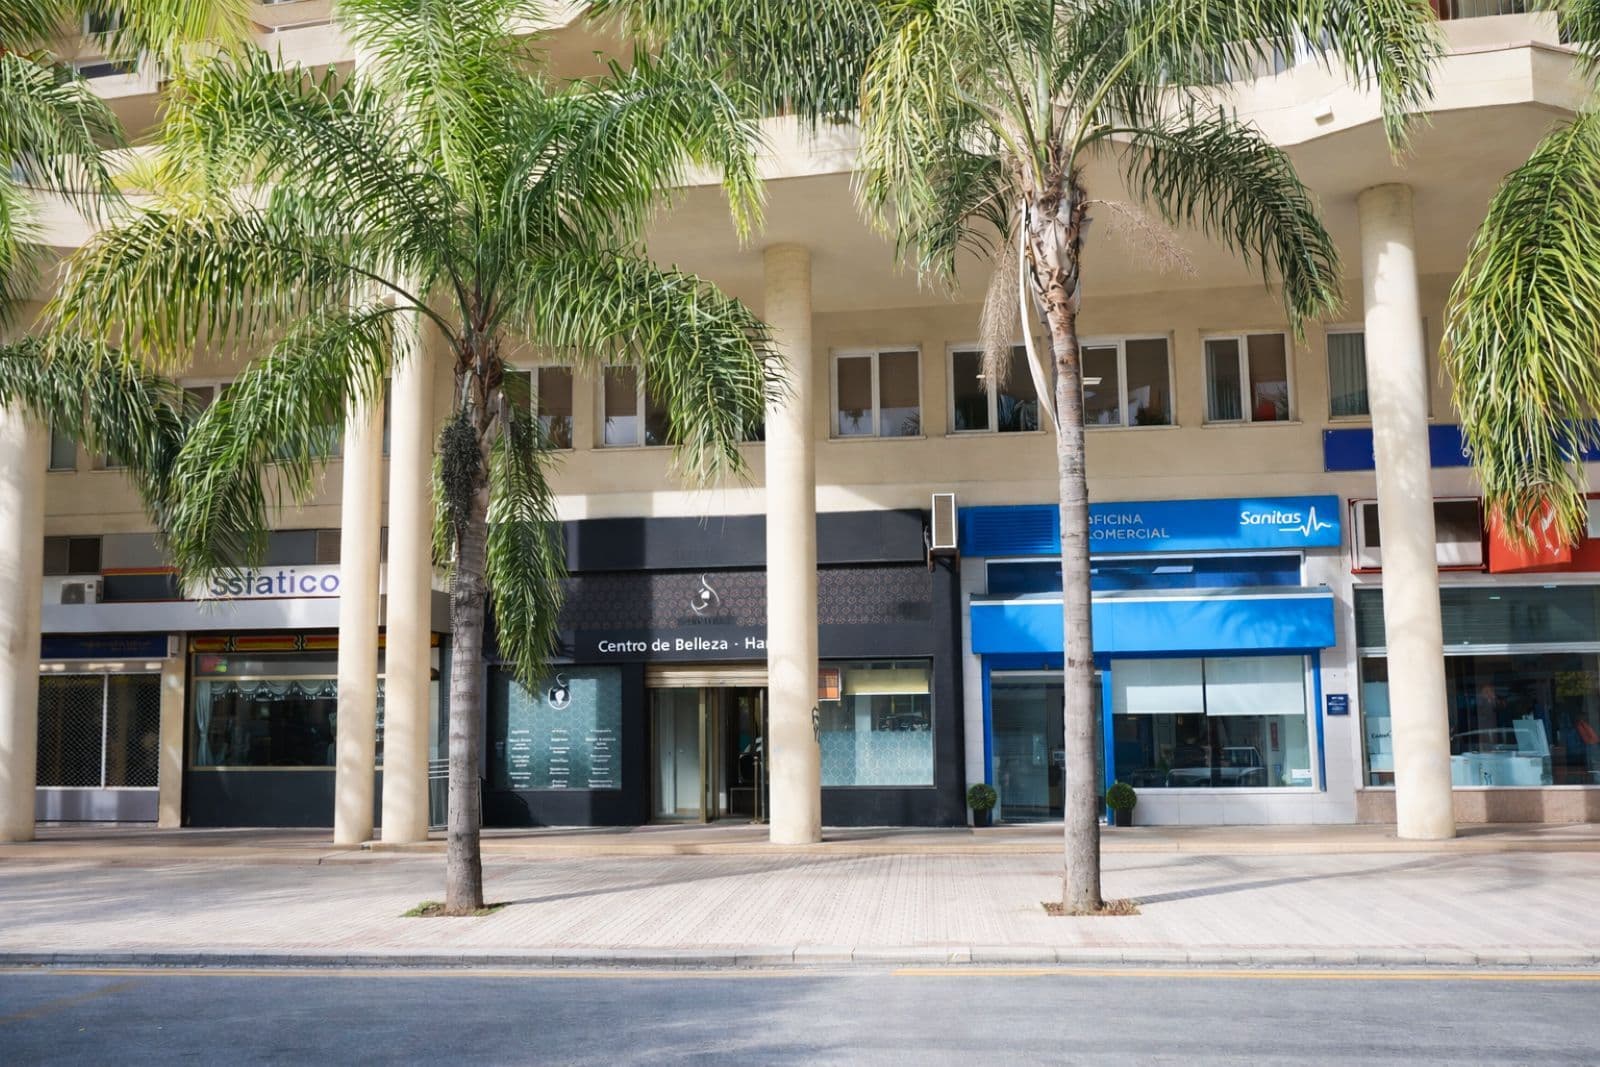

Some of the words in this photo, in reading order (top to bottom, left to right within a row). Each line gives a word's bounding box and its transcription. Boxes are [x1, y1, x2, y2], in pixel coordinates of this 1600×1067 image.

[1239, 510, 1302, 525] Sanitas
[1087, 527, 1171, 540] OMERCIAL
[598, 638, 648, 653] Centro
[651, 638, 670, 652] de
[675, 636, 728, 651] Belleza
[744, 636, 767, 650] Ha
